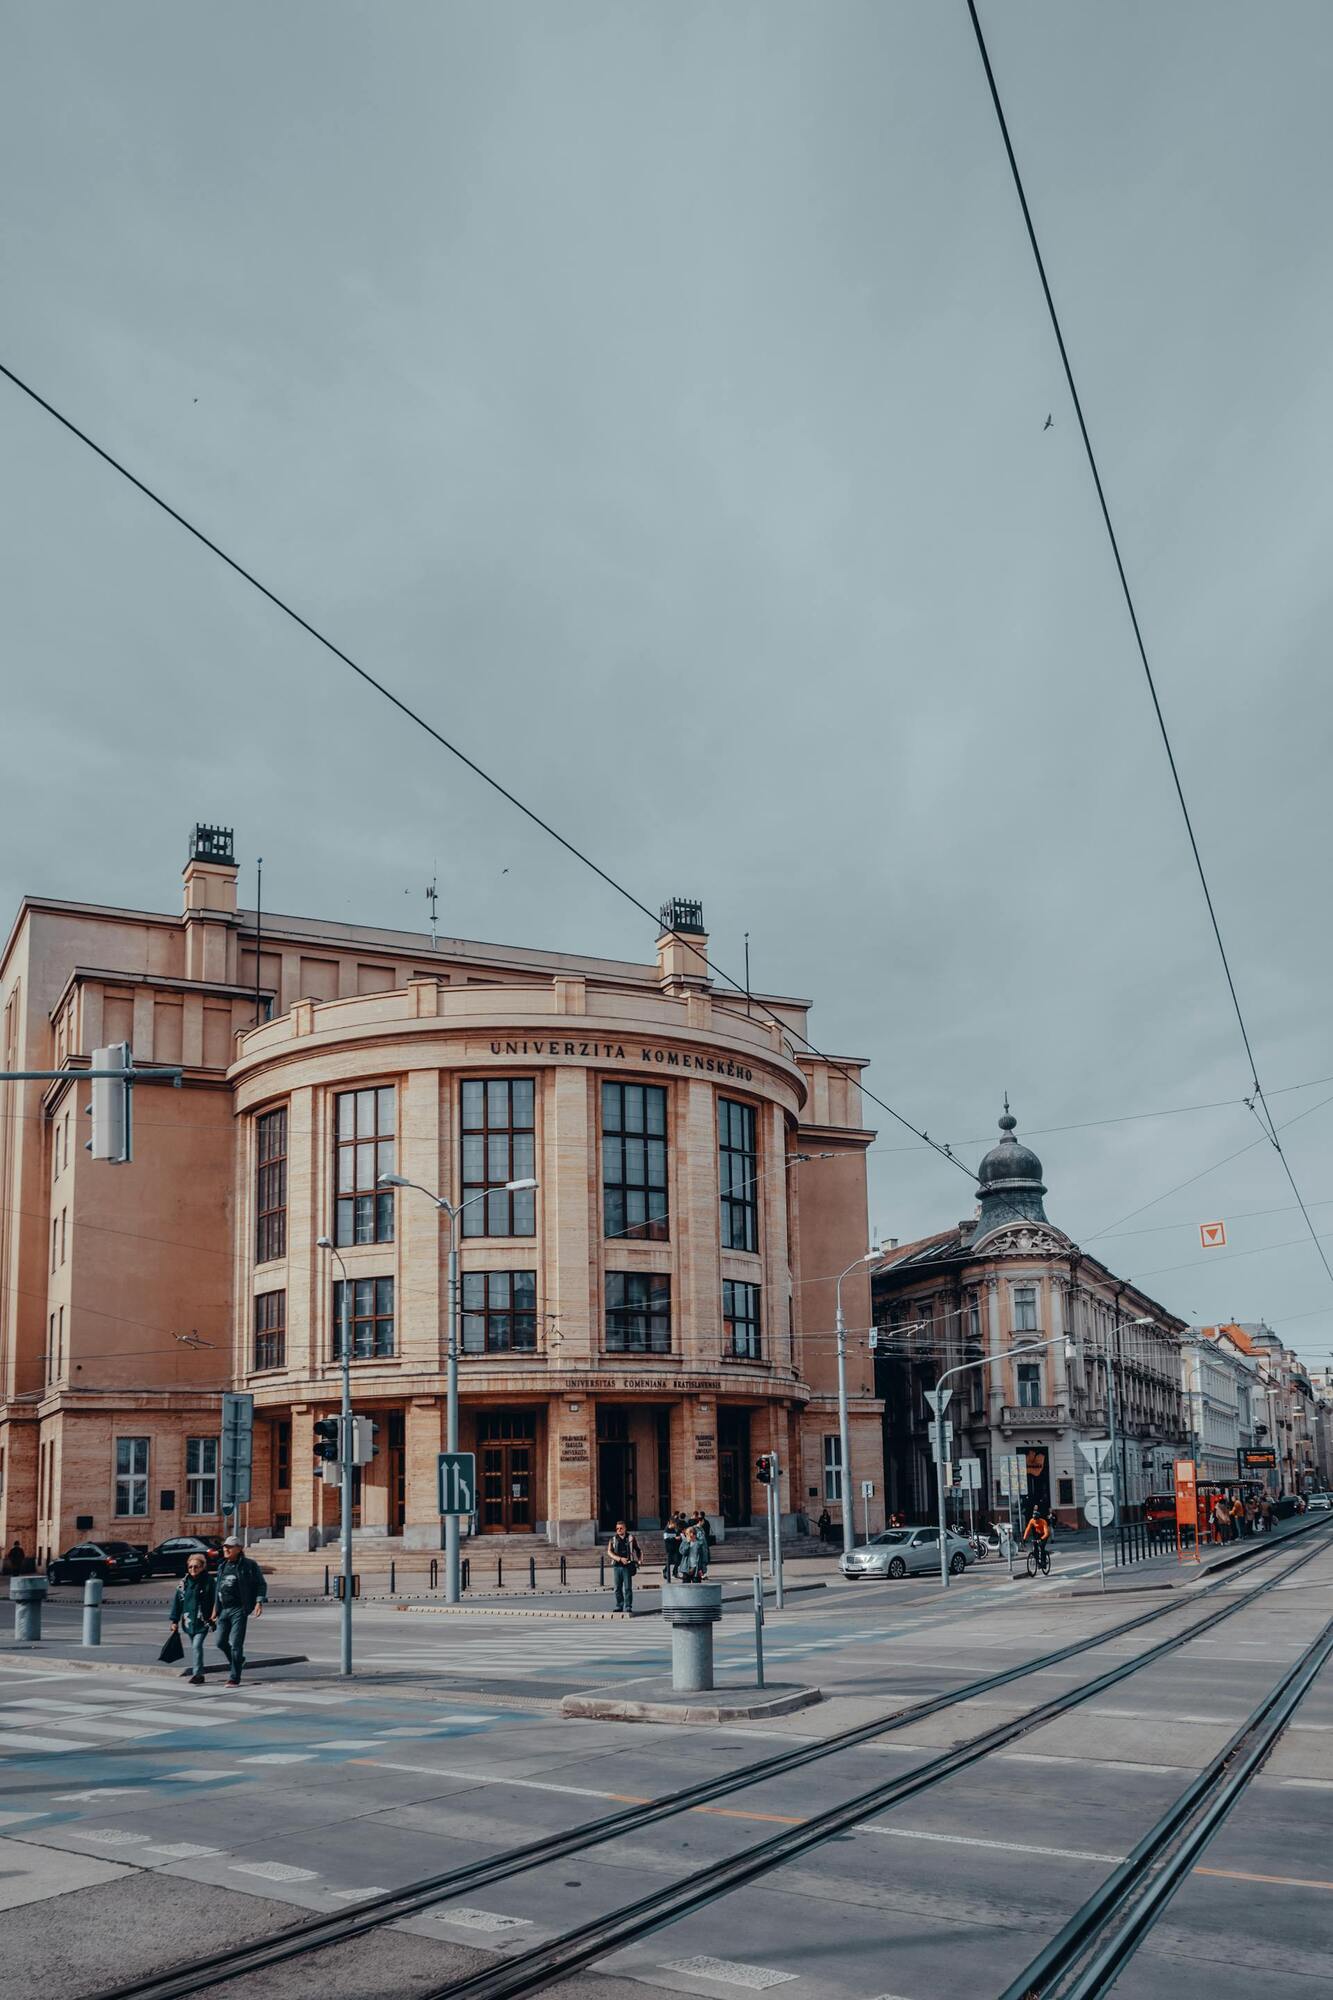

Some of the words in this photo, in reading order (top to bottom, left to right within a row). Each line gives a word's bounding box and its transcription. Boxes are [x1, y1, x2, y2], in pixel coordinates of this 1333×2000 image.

[490, 1041, 626, 1059] UNIVERZITA
[642, 1048, 753, 1082] KOMENSKÉHO
[566, 1379, 616, 1388] UNIVERSITAS
[624, 1379, 667, 1388] COMENIANA
